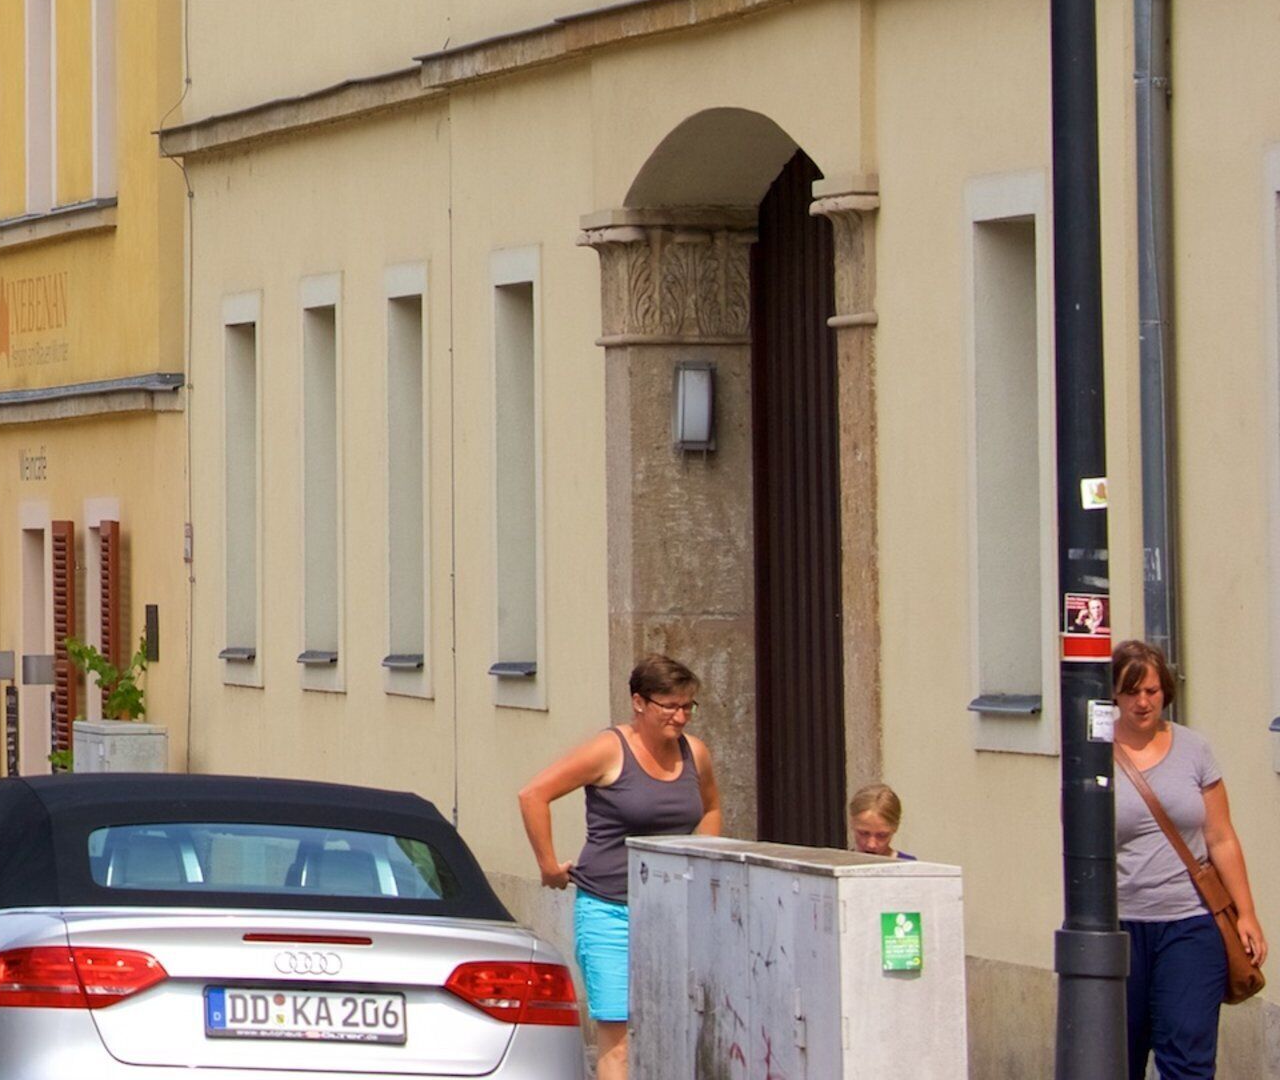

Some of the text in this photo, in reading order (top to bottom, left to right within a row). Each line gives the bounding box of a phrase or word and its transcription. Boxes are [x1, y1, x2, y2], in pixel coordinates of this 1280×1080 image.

[10, 271, 69, 336] NEBENAN
[229, 994, 269, 1024] DD
[292, 995, 333, 1026] KA
[341, 997, 400, 1028] 206
